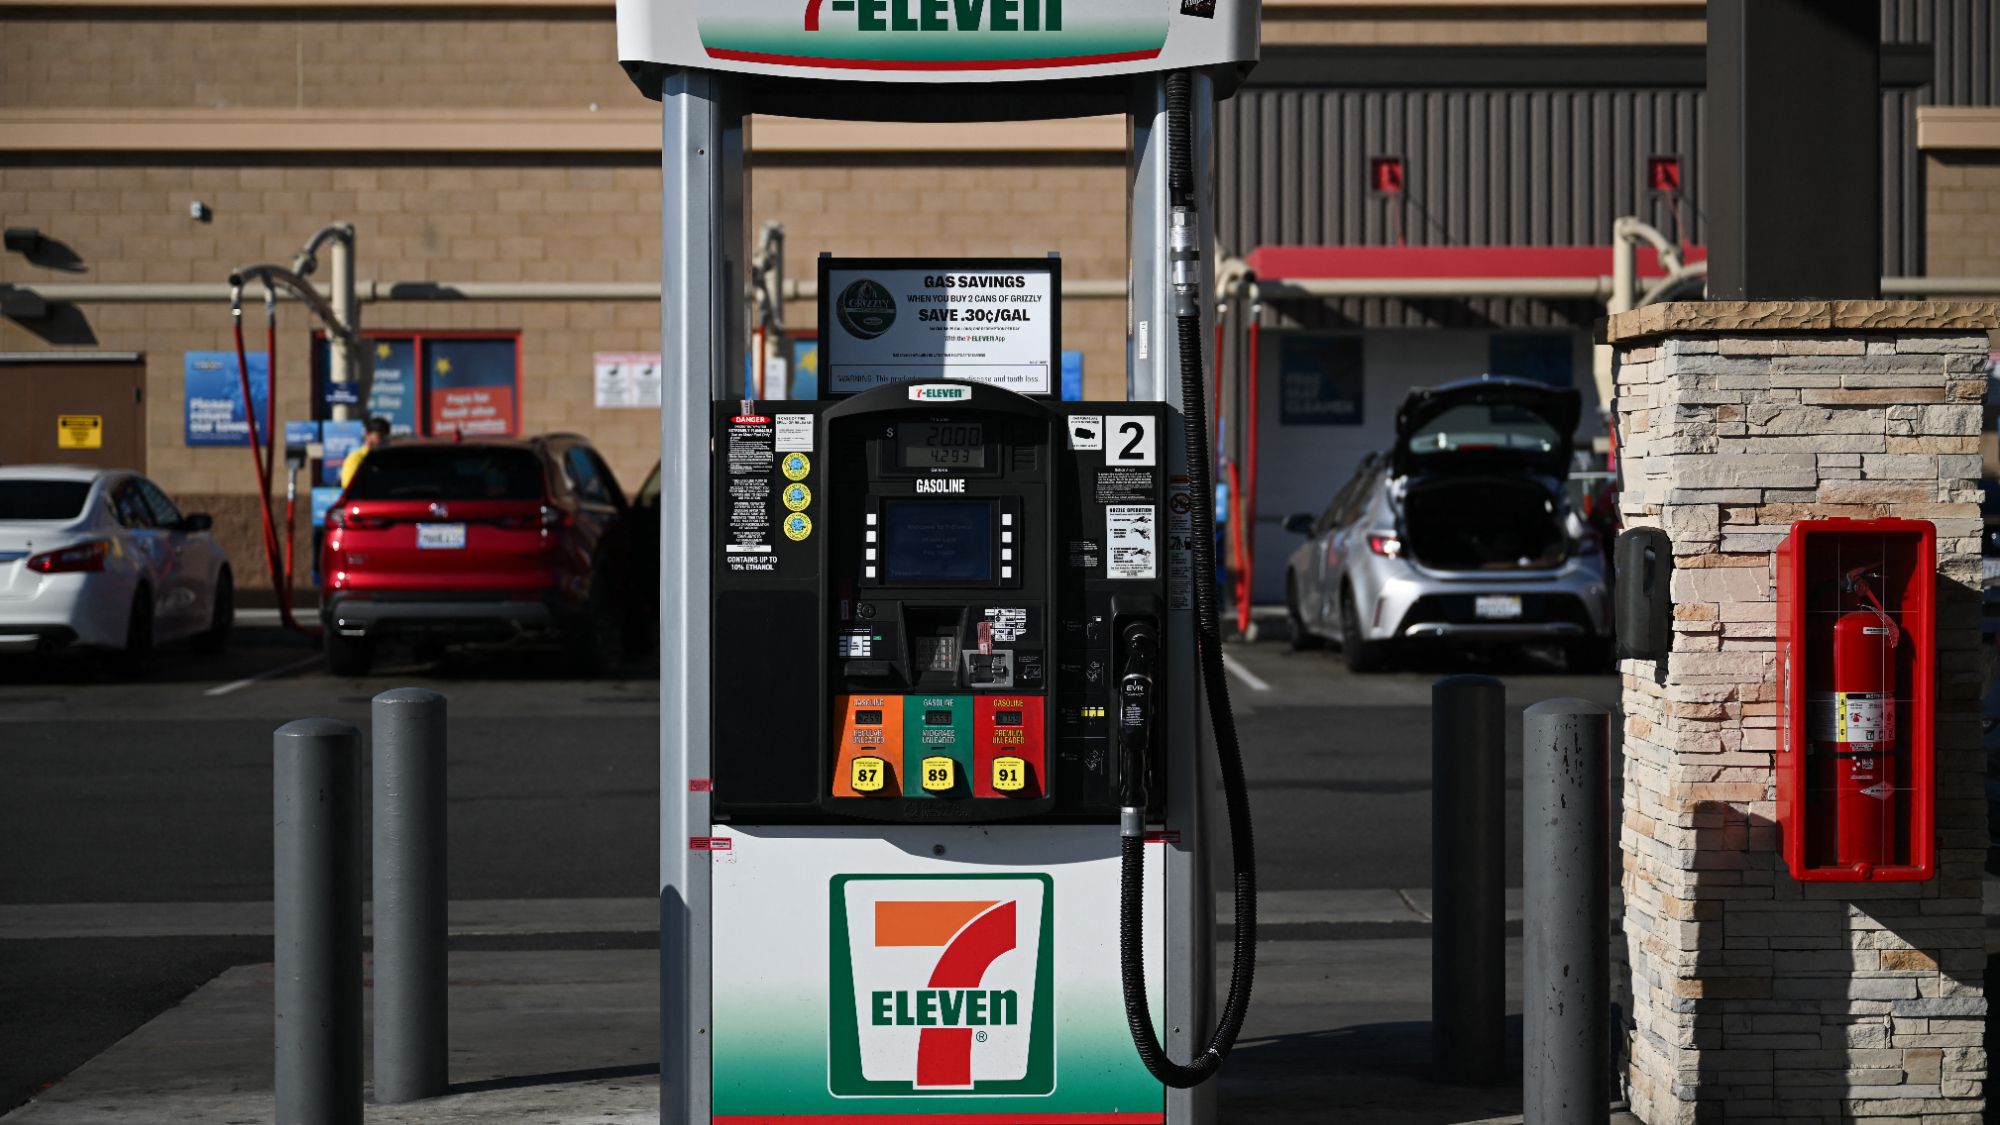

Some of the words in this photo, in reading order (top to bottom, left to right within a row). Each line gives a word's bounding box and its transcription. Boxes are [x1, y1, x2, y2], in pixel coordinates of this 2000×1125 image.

[924, 275, 955, 288] GAS
[958, 275, 1025, 288] SAVINGS
[907, 295, 931, 303] WHEN
[932, 295, 949, 303] YOU
[950, 295, 967, 303] BUY
[974, 295, 997, 303] CANS
[998, 295, 1008, 303] OF
[1010, 295, 1042, 303] GRIZZLY
[918, 308, 958, 321] SAVE
[960, 308, 1031, 323] .30¢/GAL
[1118, 421, 1145, 460] 2
[930, 449, 970, 463] 4.293
[916, 479, 965, 493] GASOLINE
[727, 556, 758, 564] CONTAINS
[759, 556, 768, 564] UP
[769, 556, 777, 564] TO
[1126, 684, 1144, 692] EVR
[853, 699, 885, 707] GASOLINE
[922, 699, 954, 707] GASOLINE
[993, 699, 1024, 707] GASOLINE
[857, 769, 877, 782] 87
[928, 769, 947, 782] 89
[998, 769, 1017, 782] 91
[874, 901, 1016, 1086] 7
